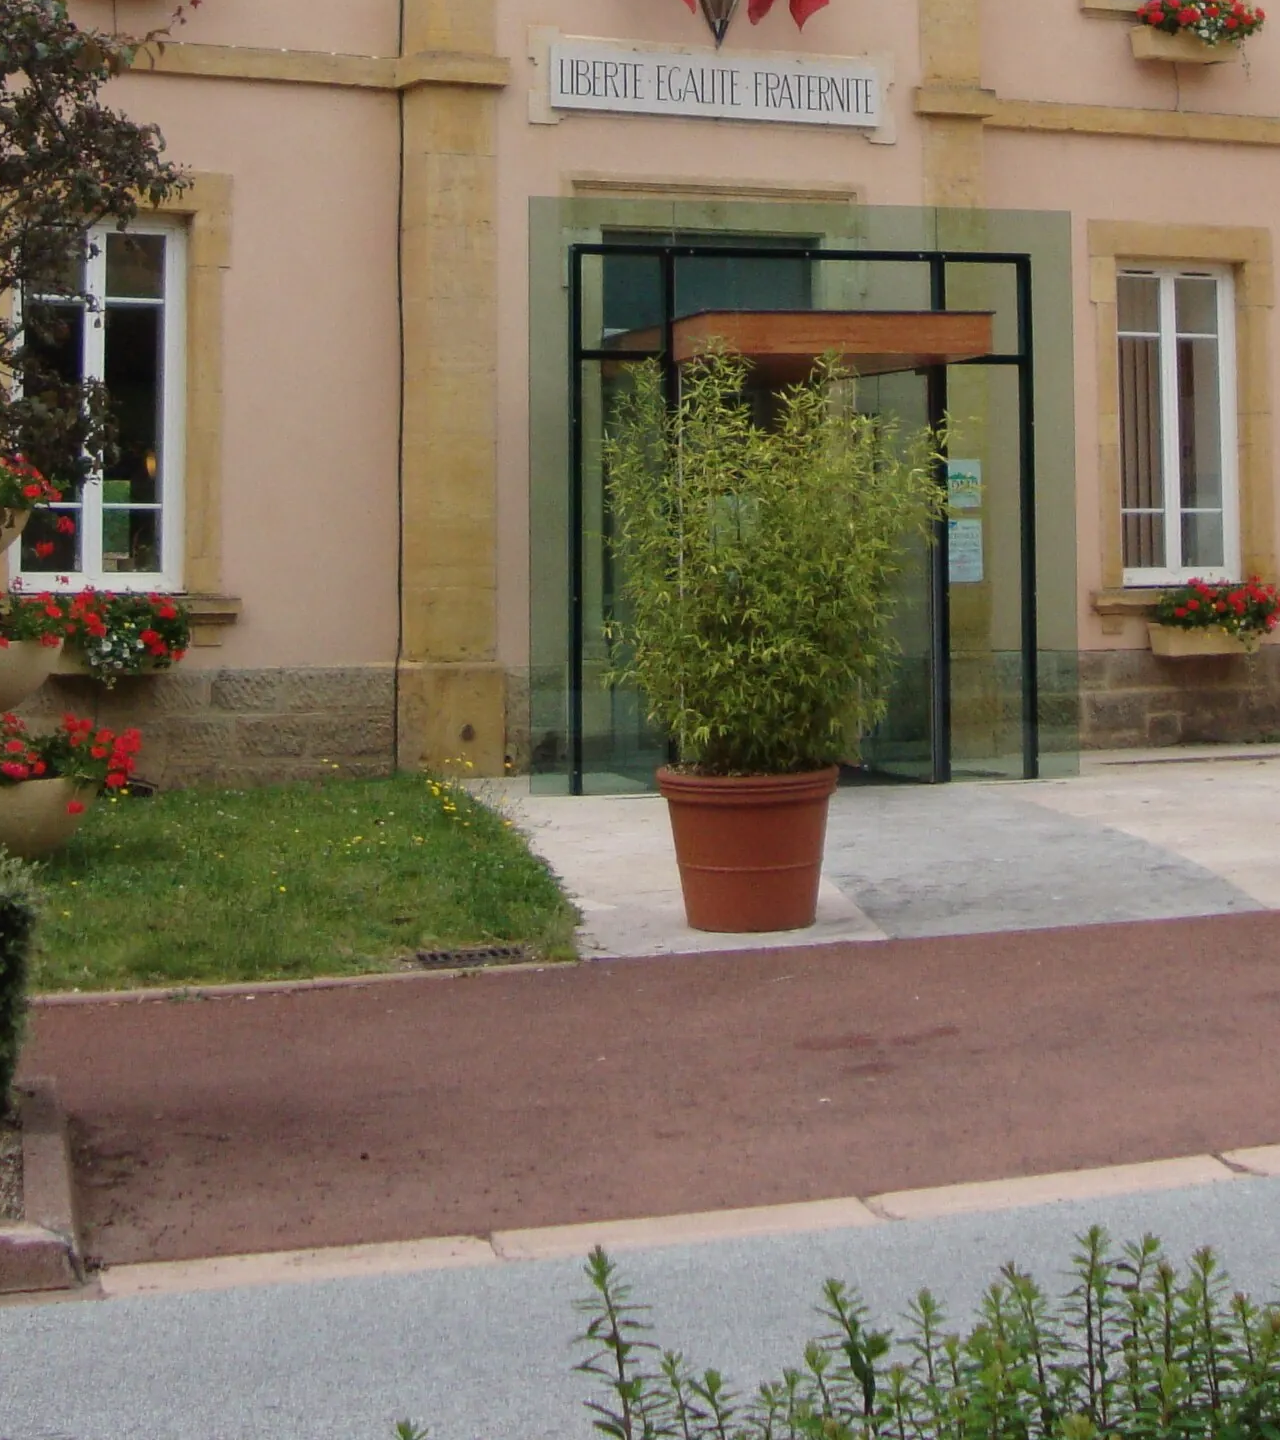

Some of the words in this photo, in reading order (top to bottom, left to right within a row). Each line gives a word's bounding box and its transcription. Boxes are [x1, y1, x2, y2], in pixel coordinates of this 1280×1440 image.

[559, 59, 645, 100] LIBERTE
[656, 65, 742, 106] EGALITE
[754, 72, 874, 115] FRATERNITE
